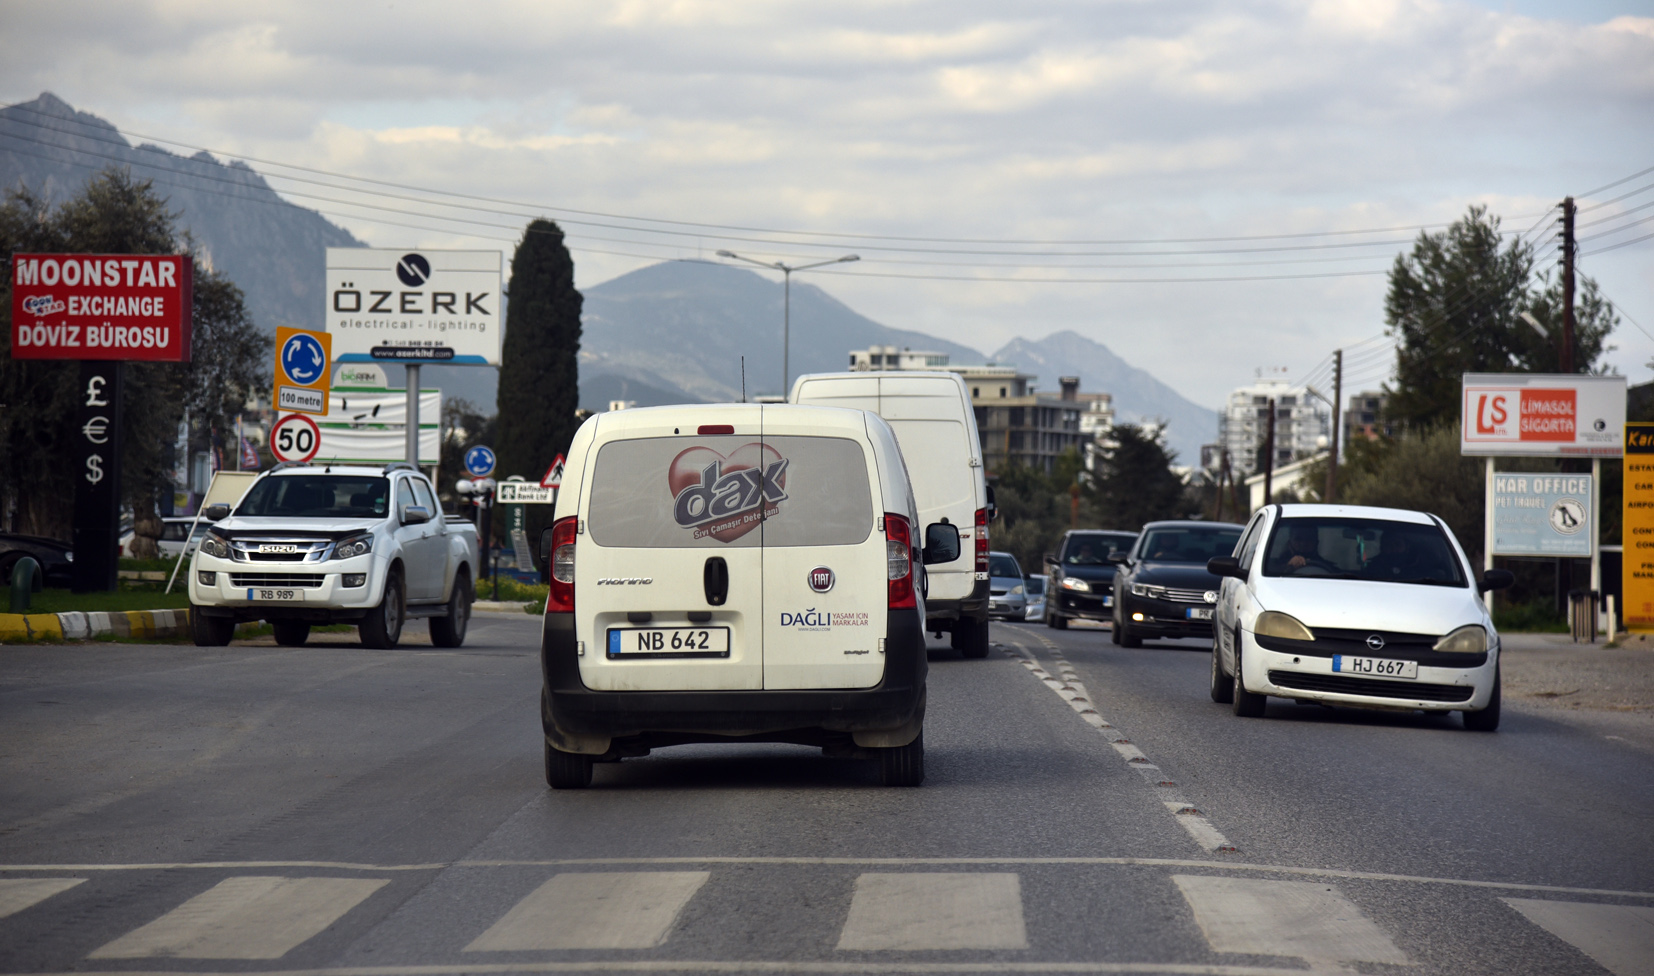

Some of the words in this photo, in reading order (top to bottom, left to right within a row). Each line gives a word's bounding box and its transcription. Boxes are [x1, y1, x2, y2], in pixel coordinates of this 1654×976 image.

[16, 258, 176, 288] MOONSTAR
[68, 296, 164, 317] EXCHANGE
[333, 281, 492, 316] ÖZERK
[18, 320, 81, 347] DÖVİZ
[86, 322, 170, 348] BÜROSU
[340, 319, 414, 330] electrical
[428, 319, 486, 332] lighting
[281, 392, 296, 403] 100
[297, 396, 321, 407] metre
[278, 428, 313, 453] 50
[1628, 431, 1654, 447] Kar
[1629, 463, 1654, 473] ESTA
[674, 459, 789, 530] dax
[1496, 478, 1528, 494] KAR
[1533, 478, 1587, 495] OFFICE
[1635, 482, 1654, 491] CAR
[517, 493, 534, 501] Bank
[1496, 496, 1512, 508] PET
[1514, 496, 1546, 509] TRAVEL
[694, 528, 709, 539] Sıvı
[711, 518, 742, 534] Çamaşır
[743, 506, 780, 523] Detejanı
[1633, 527, 1654, 535] CON
[814, 573, 830, 586] FIAT
[260, 590, 274, 600] RB
[276, 590, 295, 600] 989
[781, 607, 831, 627] DAĞLI
[638, 632, 665, 651] NB
[671, 631, 710, 650] 642
[1353, 658, 1373, 673] HJ
[1376, 660, 1405, 675] 667
